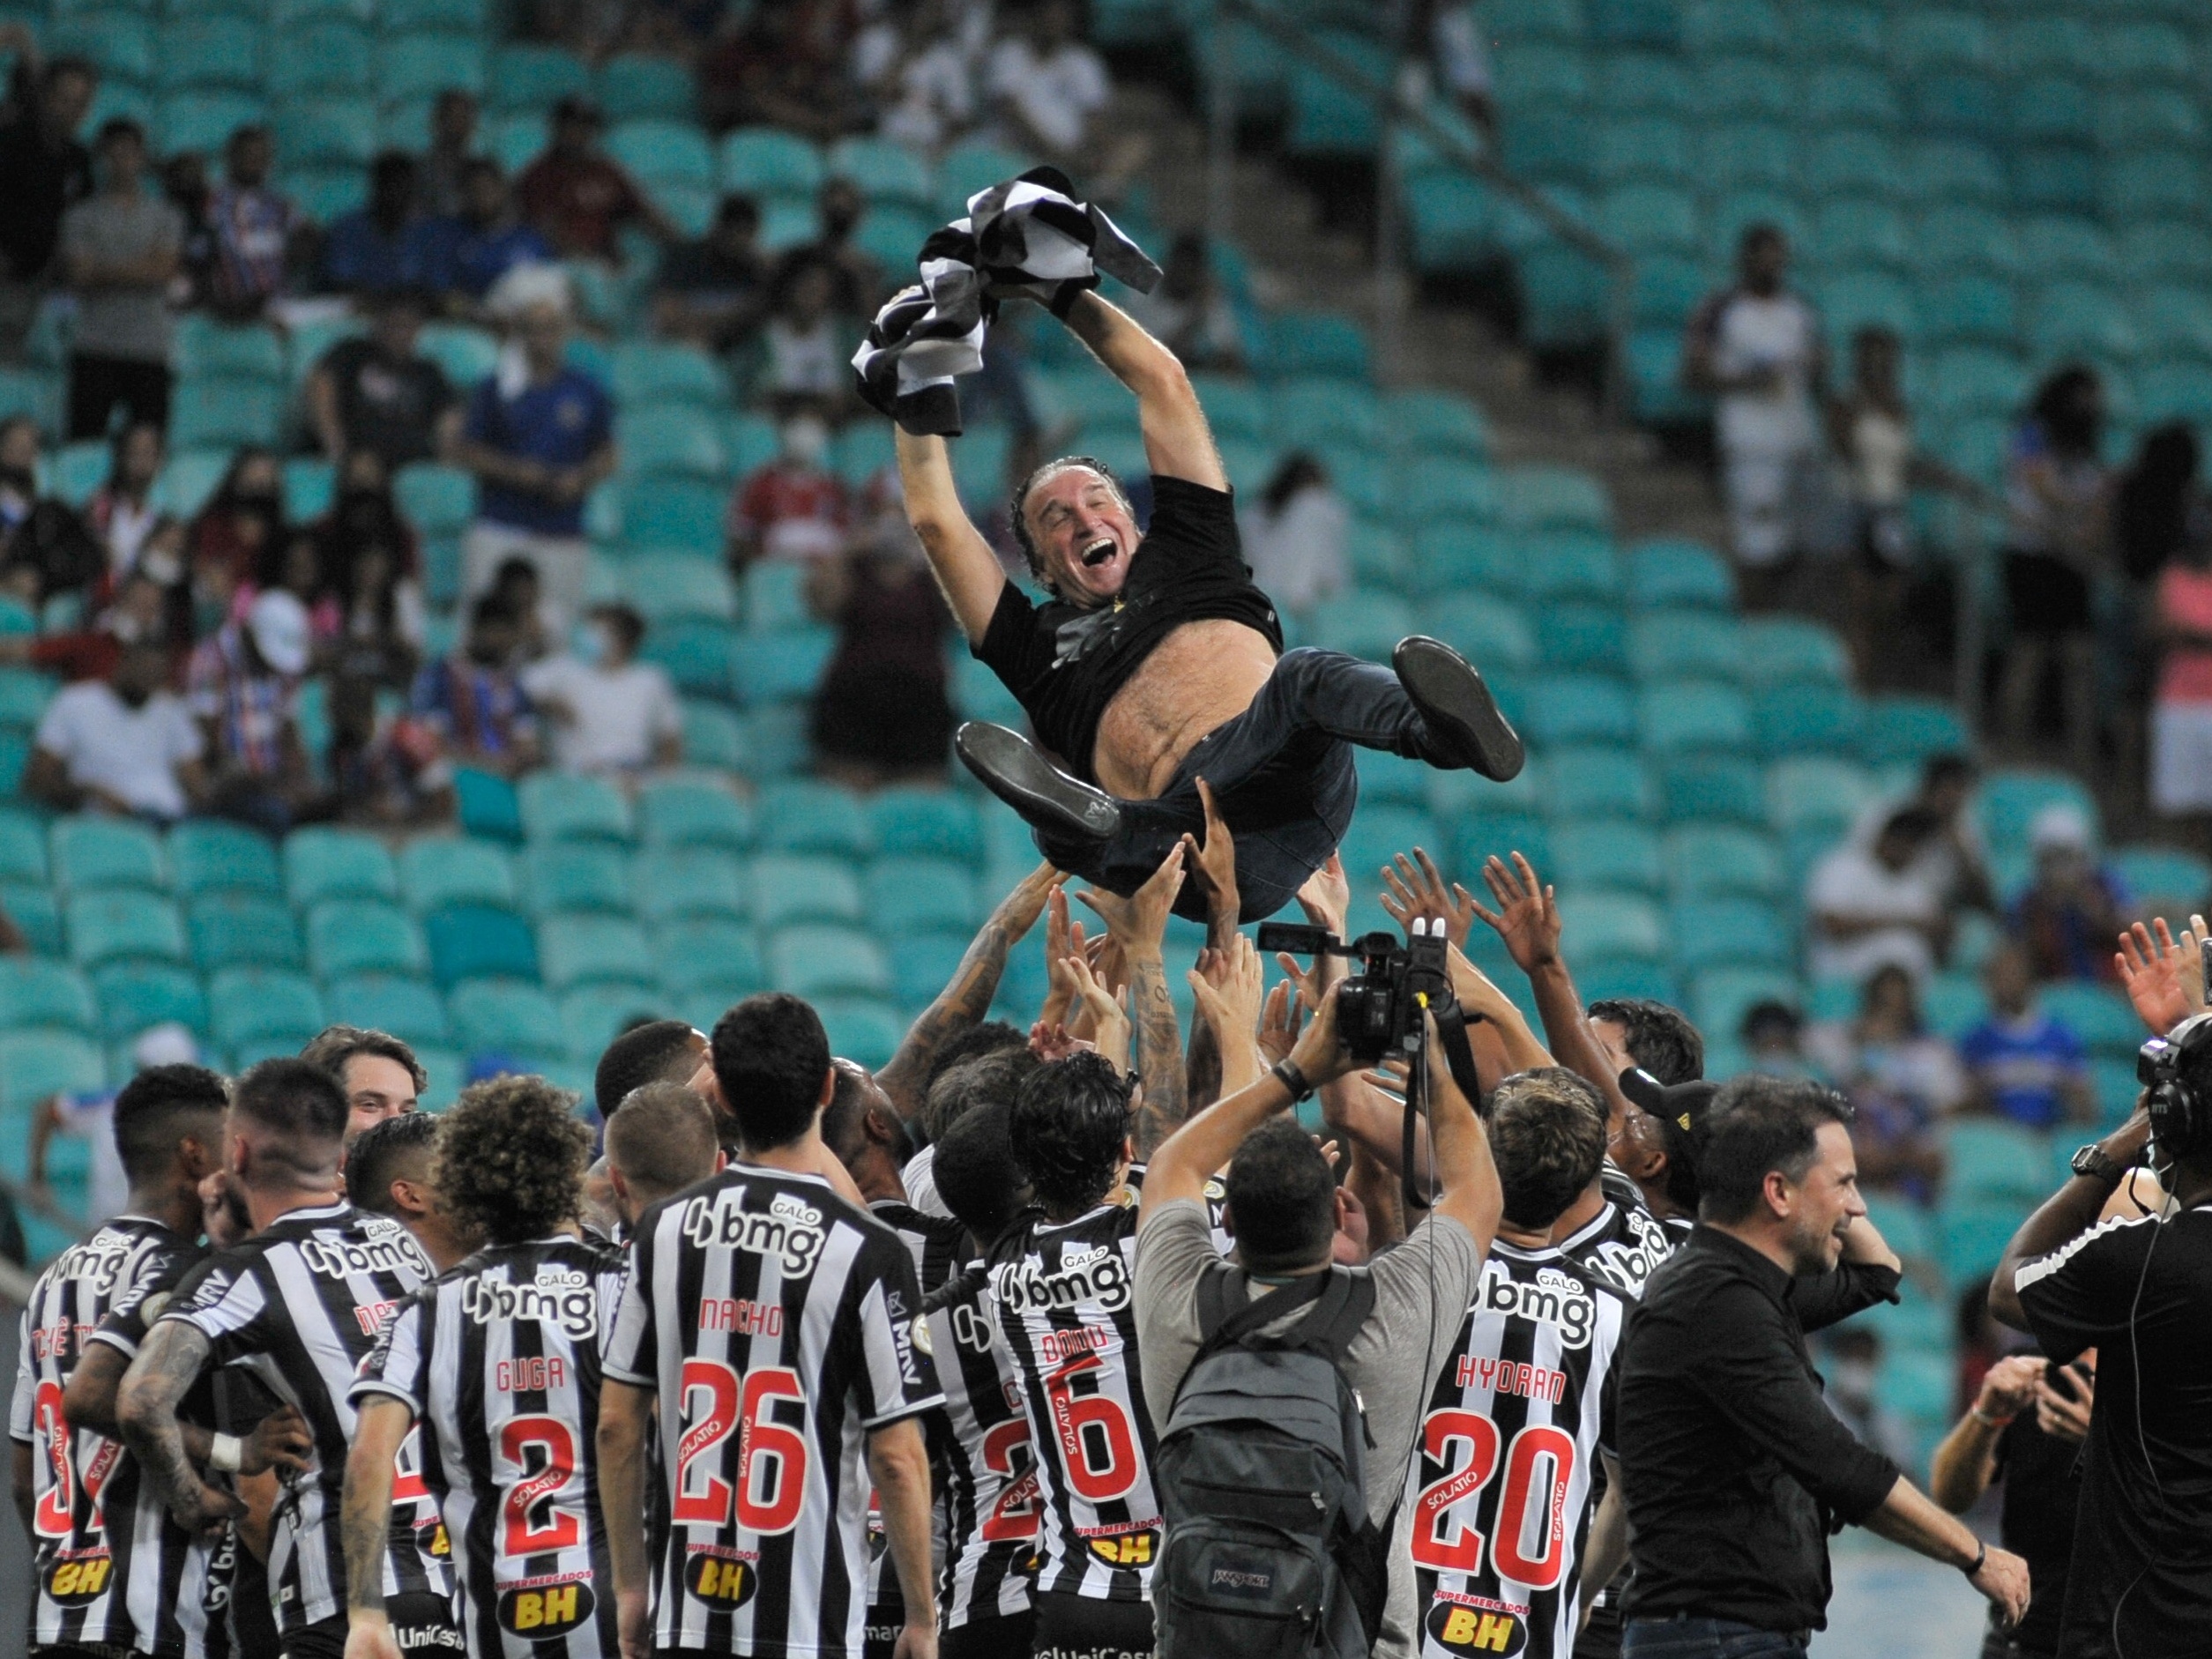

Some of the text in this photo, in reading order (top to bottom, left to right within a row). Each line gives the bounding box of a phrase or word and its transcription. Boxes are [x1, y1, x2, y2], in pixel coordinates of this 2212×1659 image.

[772, 1201, 818, 1223] GALO
[337, 1234, 430, 1278] bmg
[719, 1201, 820, 1275] bmg
[1063, 1248, 1107, 1268] GALO
[538, 1273, 584, 1287] GALO
[1024, 1259, 1128, 1308] bmg
[1538, 1275, 1582, 1291] GALO
[491, 1280, 593, 1335] bmg
[698, 1298, 786, 1338] NACHO
[1486, 1272, 1592, 1346] bmg
[495, 1357, 565, 1393] GUGA
[892, 1319, 922, 1386] MRV
[1456, 1355, 1567, 1405] HYORAN
[672, 1358, 808, 1535] 26
[679, 1419, 722, 1463] SOLATIO
[740, 1417, 753, 1478] SOLATIO
[1046, 1356, 1137, 1500] 6
[1056, 1396, 1079, 1454] SOLATIO
[500, 1415, 580, 1558] 2
[514, 1469, 564, 1508] SOLATIO
[1411, 1408, 1576, 1590] 20
[1426, 1470, 1479, 1510] SOLATIO
[1553, 1481, 1567, 1542] SOLATIO
[51, 1559, 112, 1596] BH
[495, 1569, 593, 1592] SUPERMERCADOS
[696, 1558, 744, 1602] BH
[513, 1586, 578, 1631] BH
[1434, 1589, 1532, 1615] SUPERMERCADOS
[1441, 1606, 1515, 1653] BH
